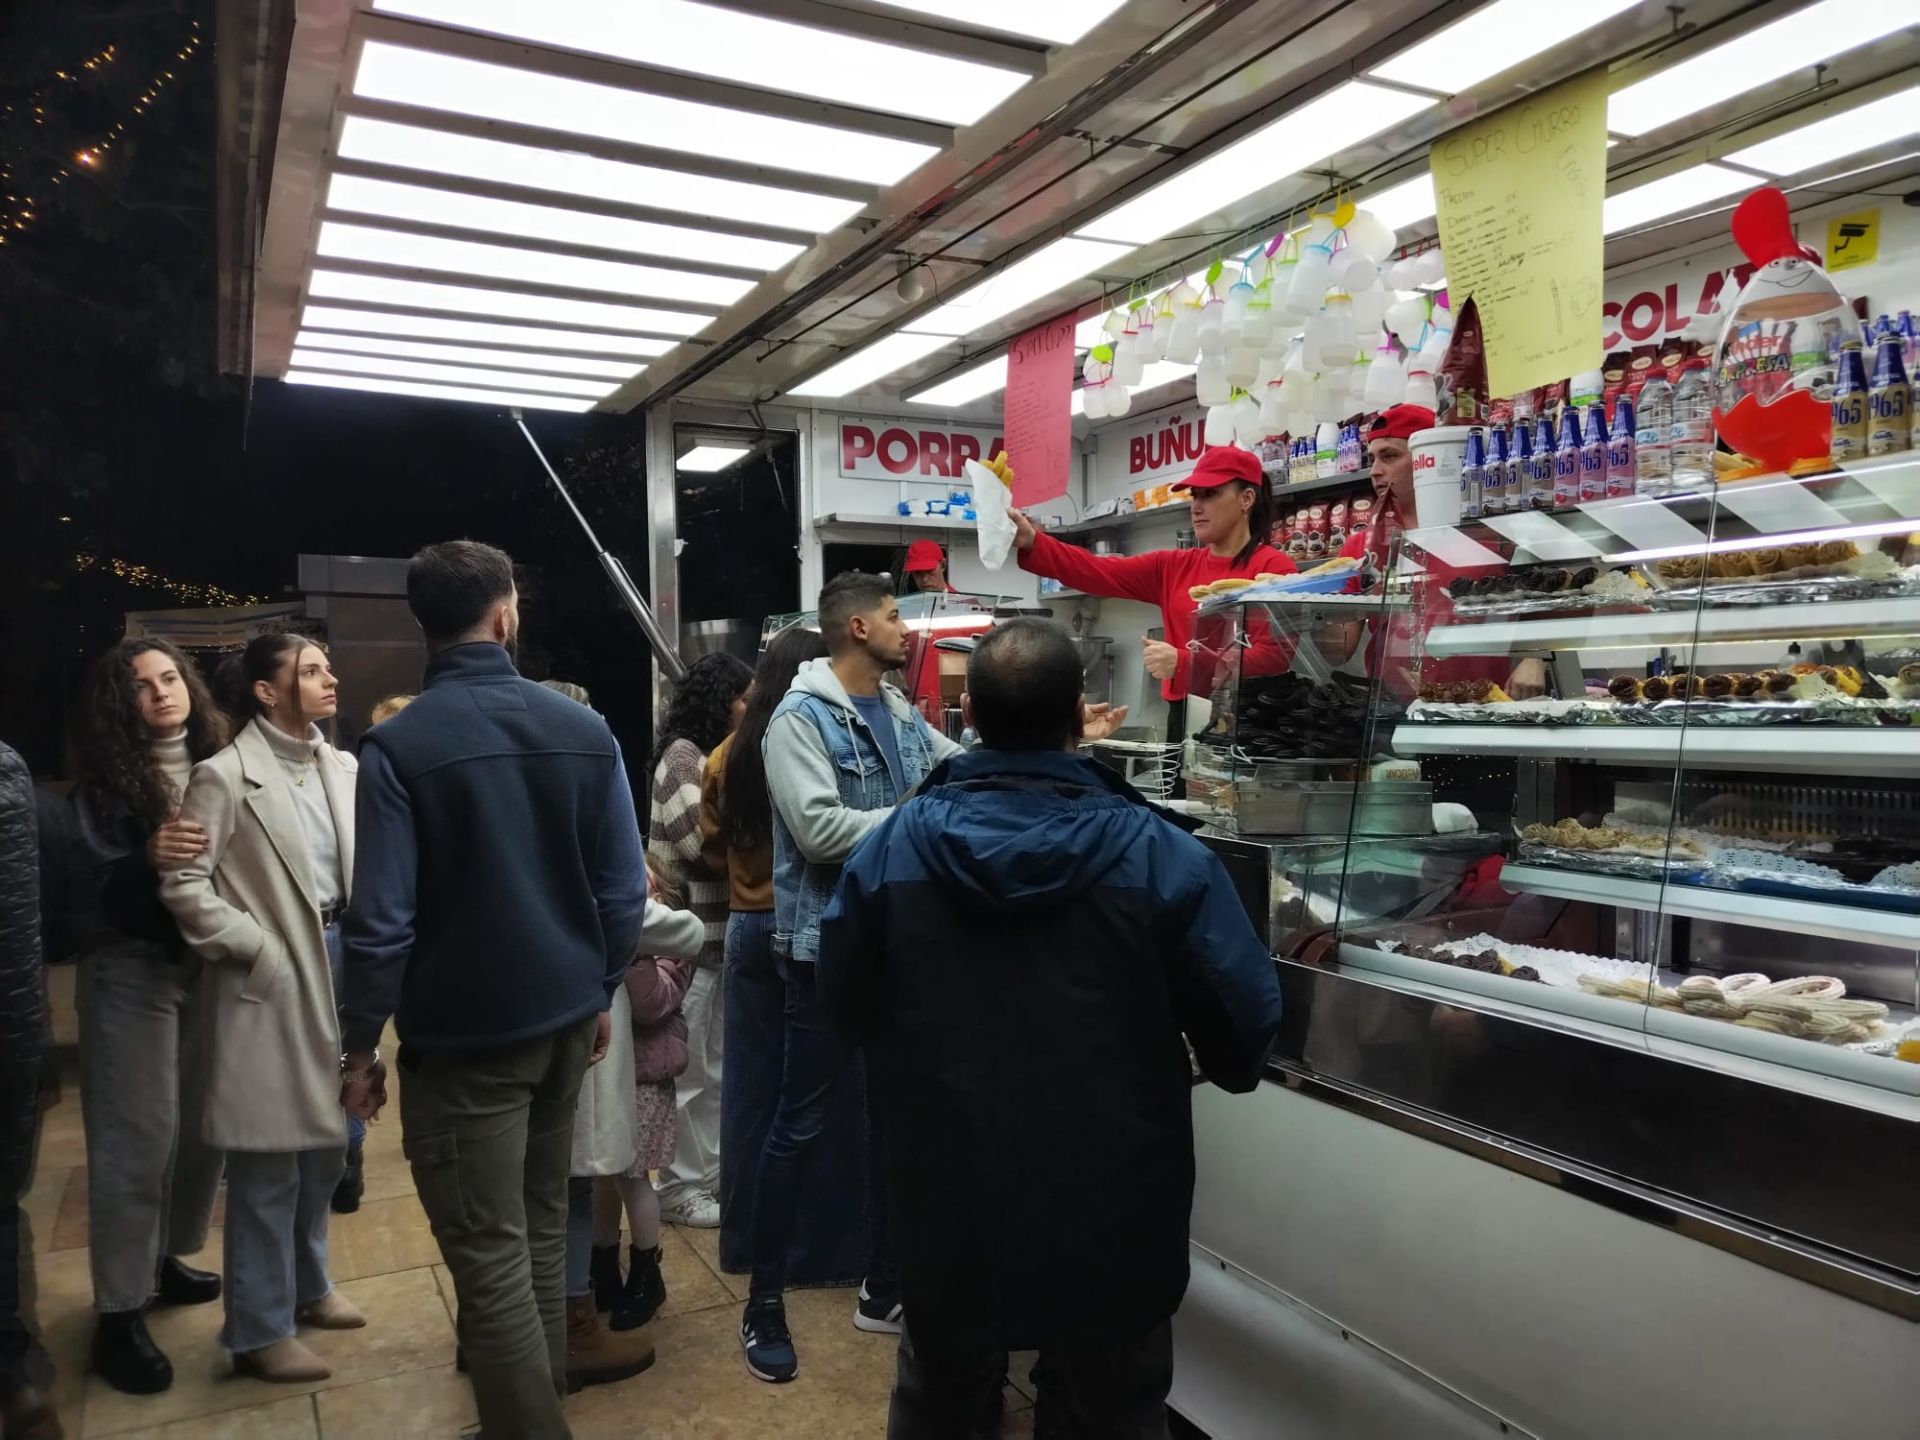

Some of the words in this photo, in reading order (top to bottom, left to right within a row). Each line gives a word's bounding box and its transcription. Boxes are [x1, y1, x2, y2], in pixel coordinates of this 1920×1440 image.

[1130, 415, 1205, 474] BUÑU
[1411, 453, 1435, 471] ella
[1482, 467, 1502, 489] 65
